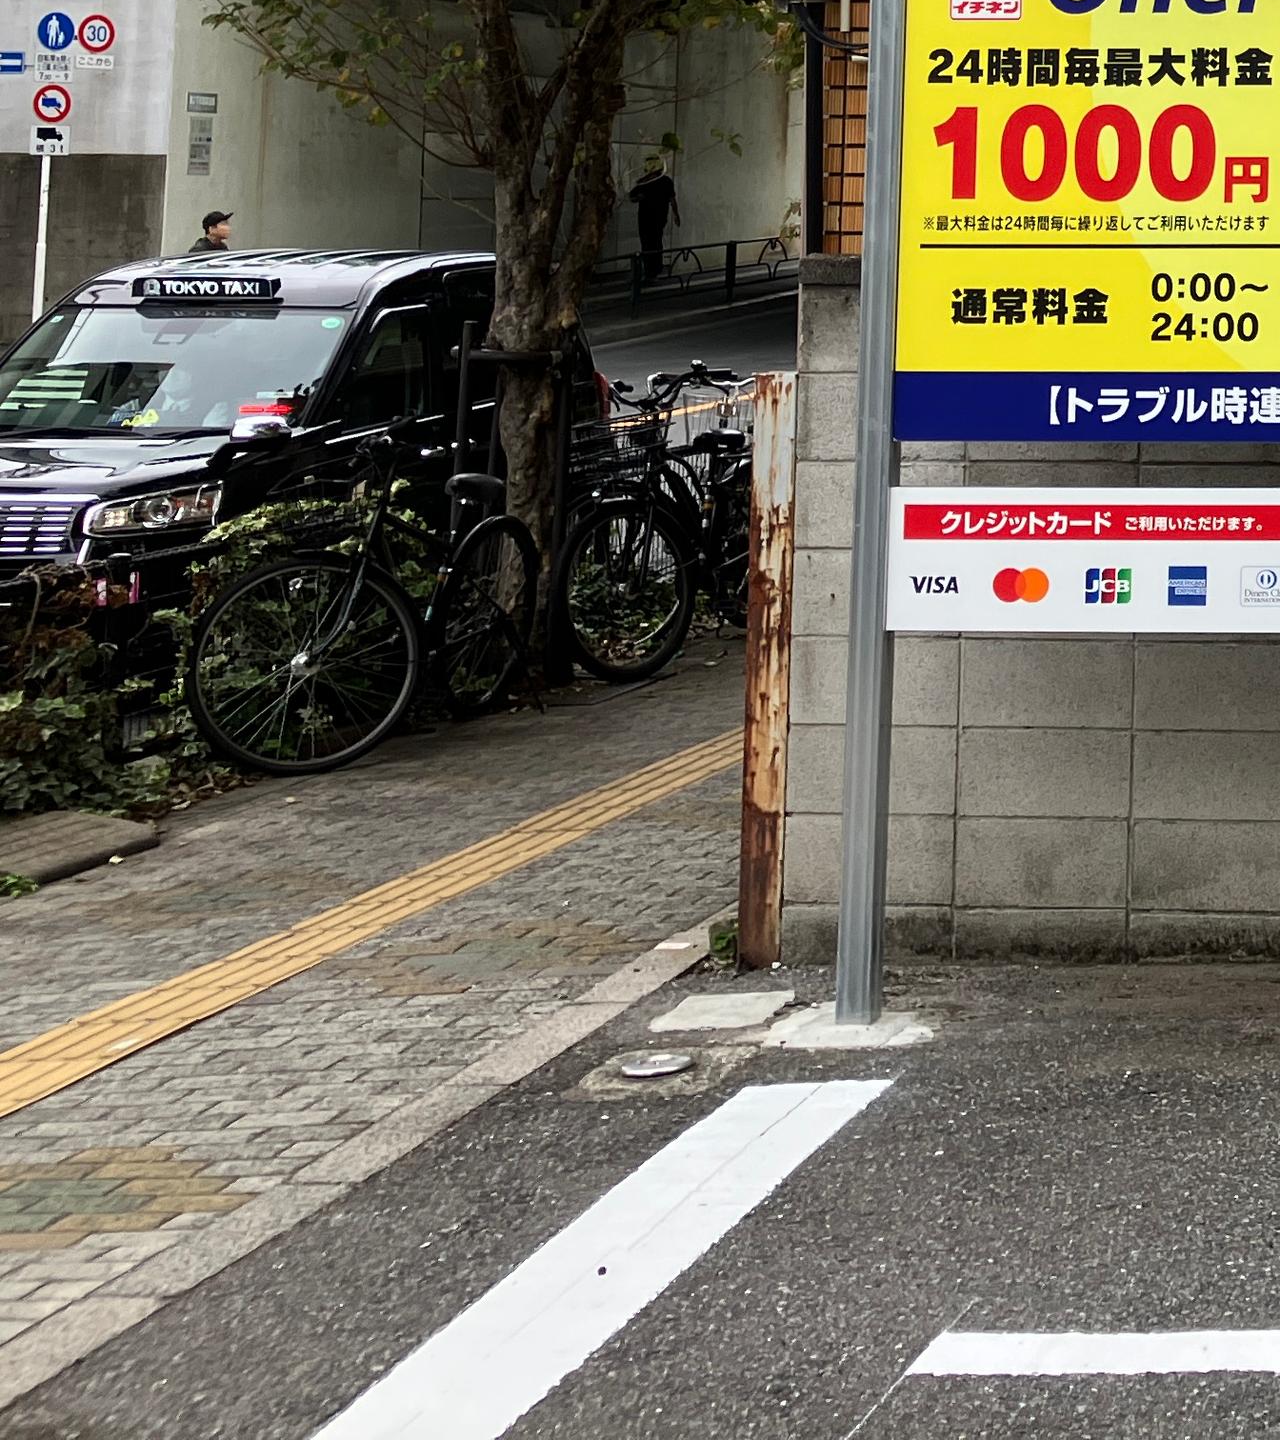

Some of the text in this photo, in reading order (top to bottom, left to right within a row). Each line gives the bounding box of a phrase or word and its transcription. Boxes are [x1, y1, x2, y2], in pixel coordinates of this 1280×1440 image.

[953, 1, 1019, 14] イチネン
[87, 26, 107, 42] 30
[78, 57, 112, 66] ここから
[927, 48, 1273, 87] 24時間毎最大料金
[934, 104, 1269, 203] 1000円
[163, 281, 259, 294] TOKYO TAXI
[952, 288, 1108, 325] 通常料金
[1151, 313, 1259, 342] 24:00
[941, 511, 1262, 534] クレジットカード ご利用いただけます。
[911, 577, 958, 593] VISA
[1086, 578, 1130, 594] JCB
[1244, 589, 1269, 597] Diners
